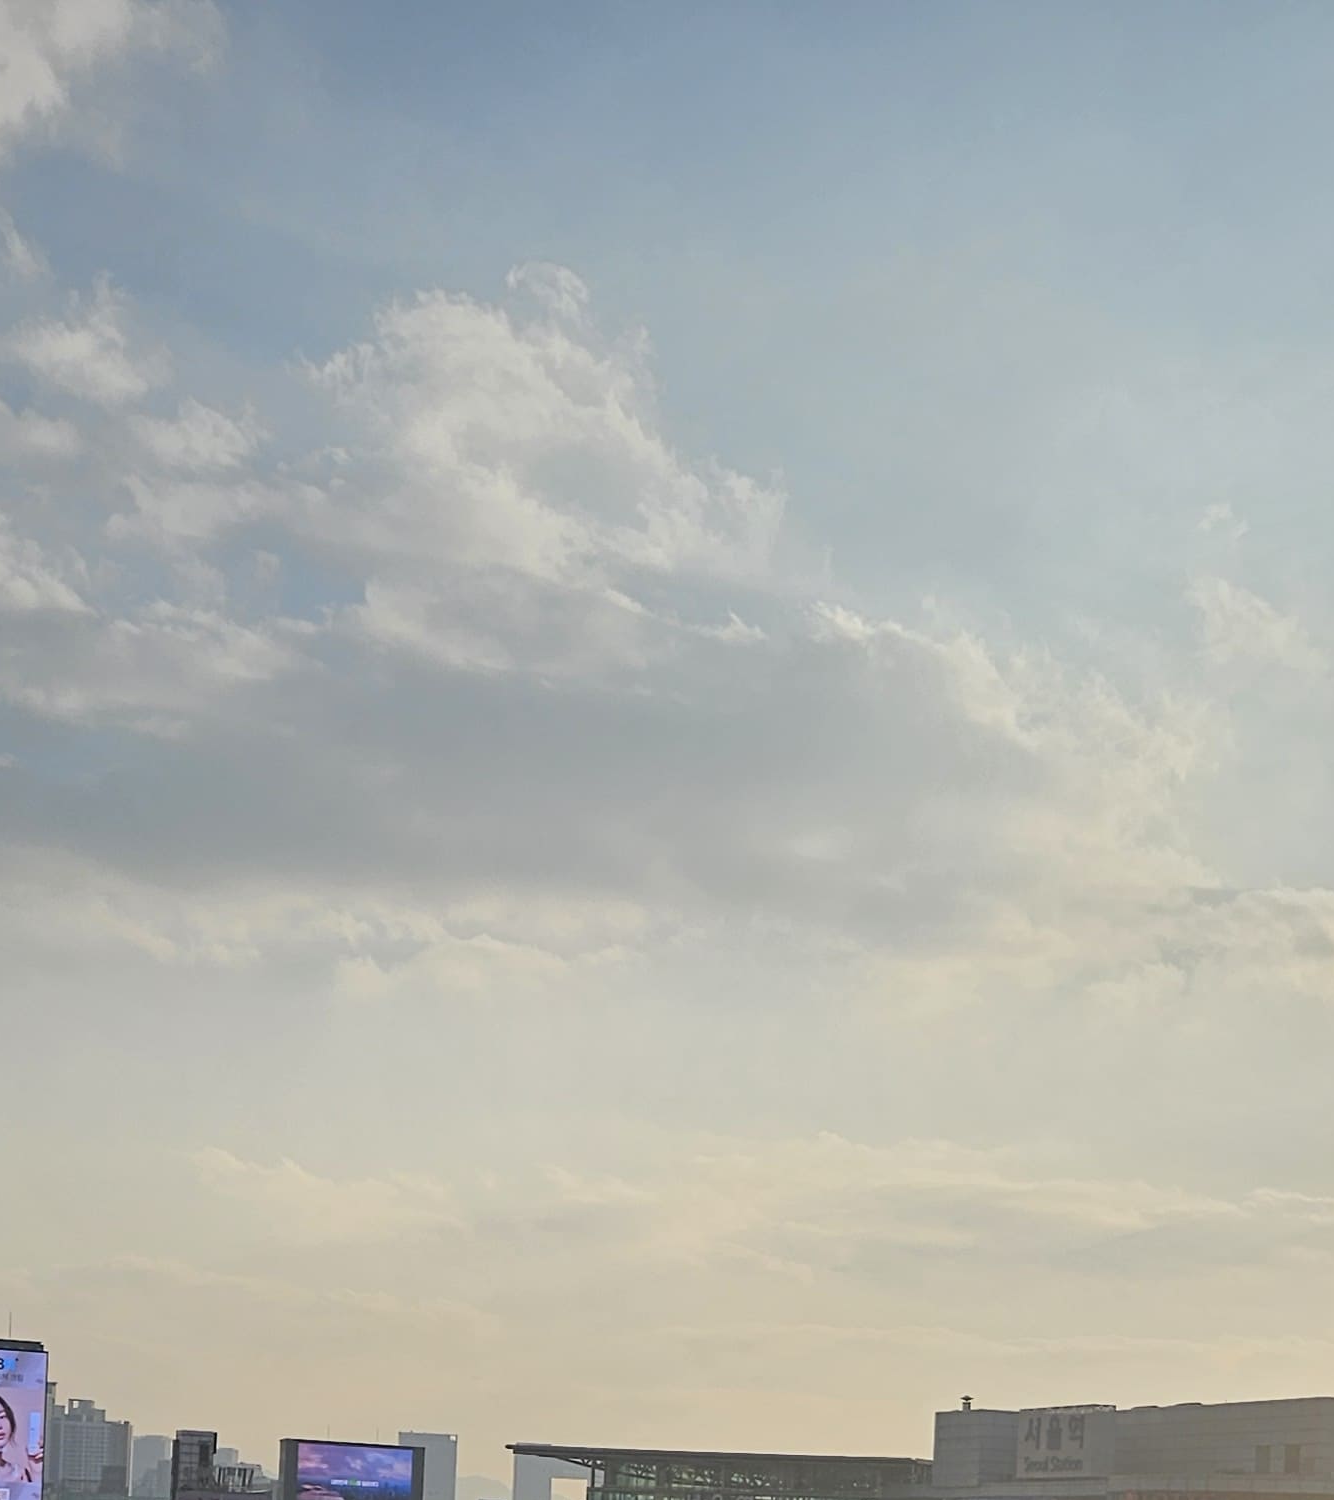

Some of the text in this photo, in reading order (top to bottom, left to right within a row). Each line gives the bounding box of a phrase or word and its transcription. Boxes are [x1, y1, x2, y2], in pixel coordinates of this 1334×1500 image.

[1024, 1415, 1085, 1450] 서울역
[1023, 1456, 1084, 1473] Seoul Station
